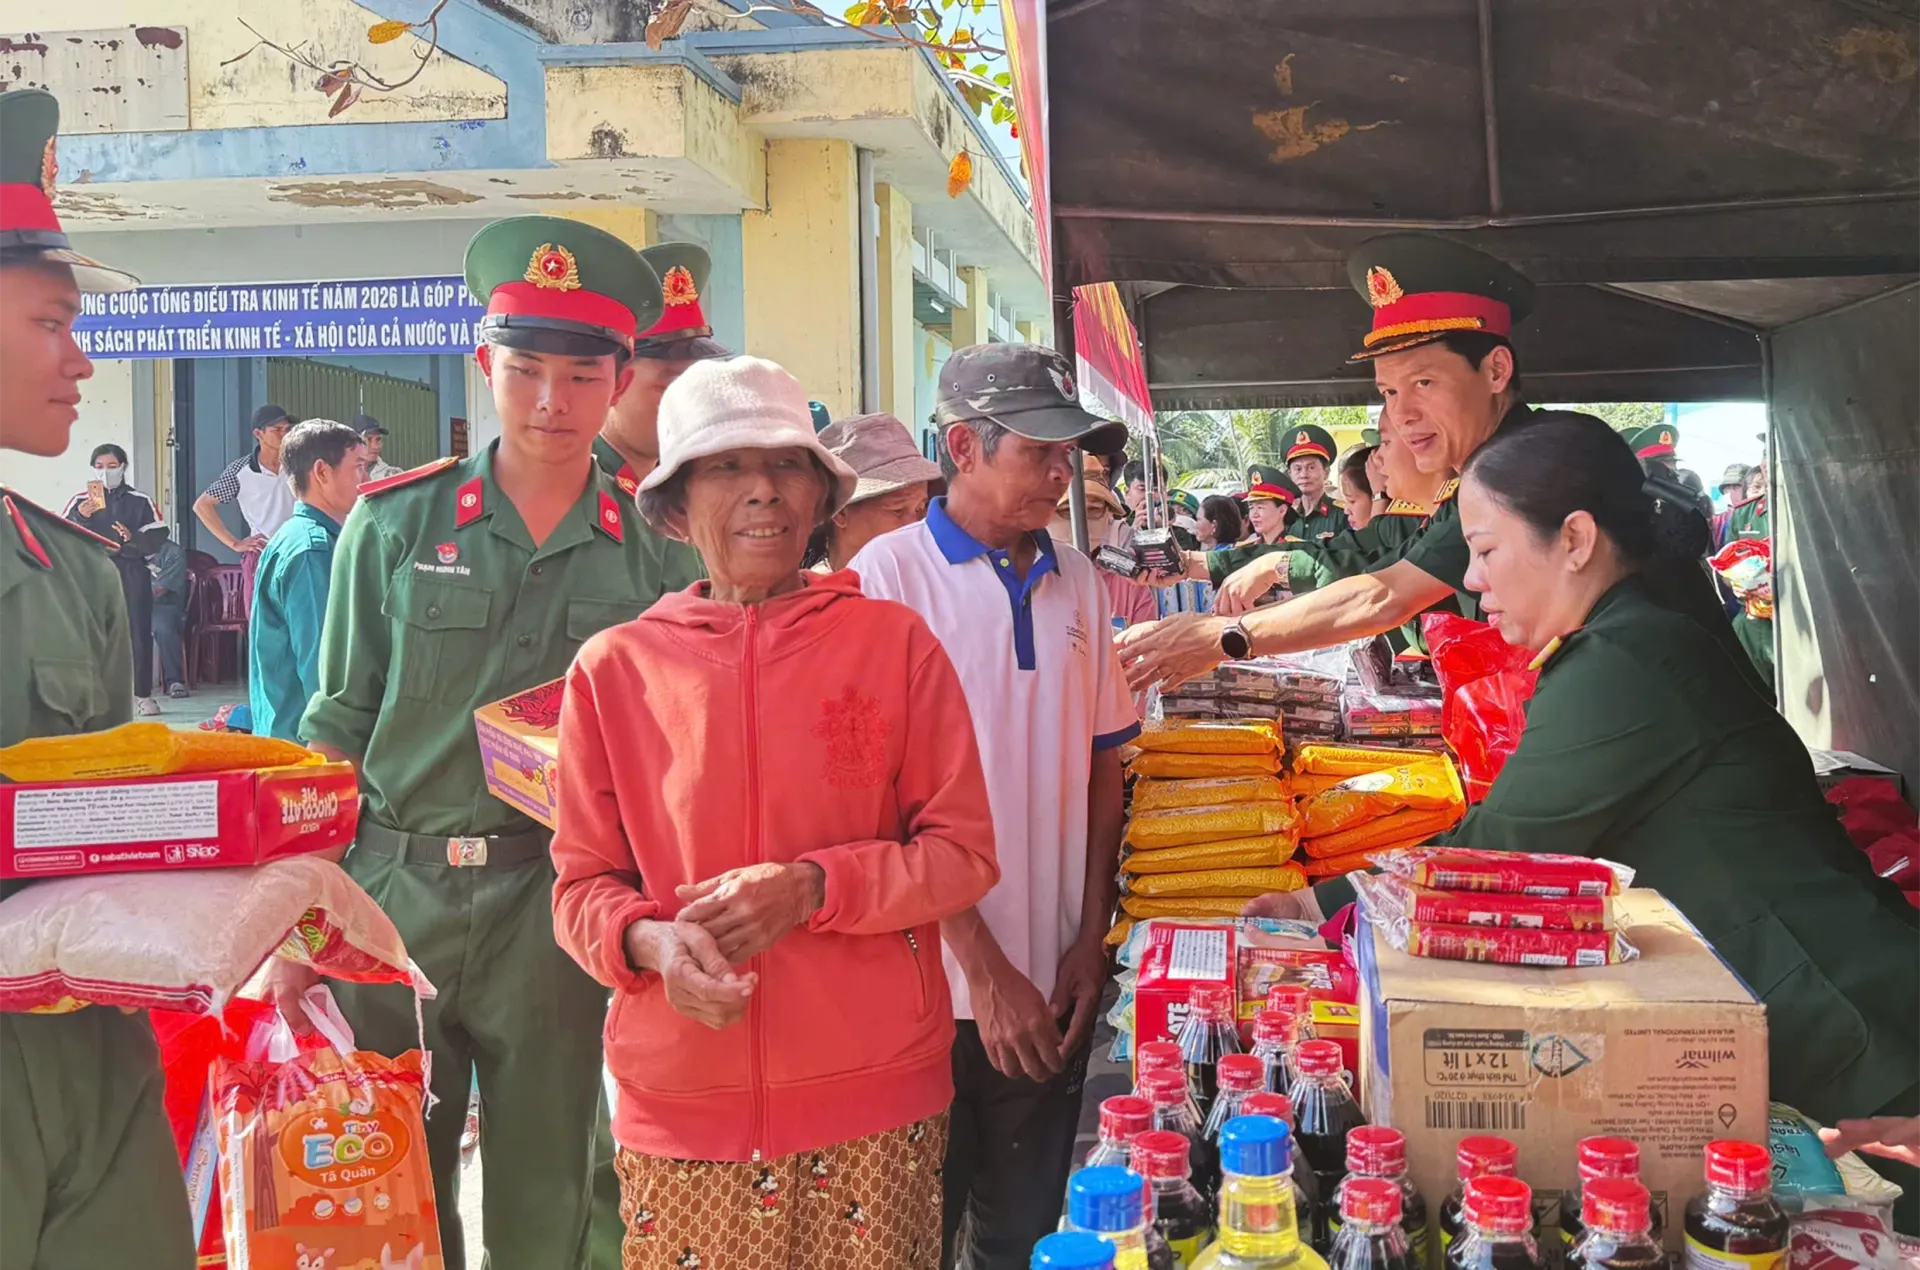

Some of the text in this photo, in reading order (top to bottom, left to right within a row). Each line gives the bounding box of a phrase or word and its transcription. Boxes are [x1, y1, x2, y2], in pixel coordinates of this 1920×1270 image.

[109, 289, 148, 319] CUỘC
[231, 289, 259, 312] TRA
[262, 288, 298, 311] KINH
[302, 283, 319, 310] TẾ
[323, 282, 357, 309] NĂM
[361, 285, 398, 309] 2026
[402, 281, 422, 308] LÀ
[424, 281, 454, 307] GÓP
[95, 326, 134, 353] SÁCH
[137, 325, 174, 351] PHÁT
[177, 319, 221, 350] TRIỂN
[224, 327, 260, 349] KINH
[264, 320, 282, 348] TẾ
[294, 322, 314, 348] XÃ
[318, 321, 343, 352] HỘI
[347, 317, 377, 347] CỦA
[381, 317, 401, 347] CẢ
[405, 319, 446, 346] NƯỚC
[450, 318, 470, 345] VÀ
[281, 792, 339, 825] CHOCOLATE
[1443, 1052, 1509, 1069] 12 x 1 lít
[1680, 1049, 1736, 1063] wilmar
[344, 1119, 379, 1135] Tiny
[303, 1132, 394, 1169] ECO
[320, 1170, 338, 1183] Tã
